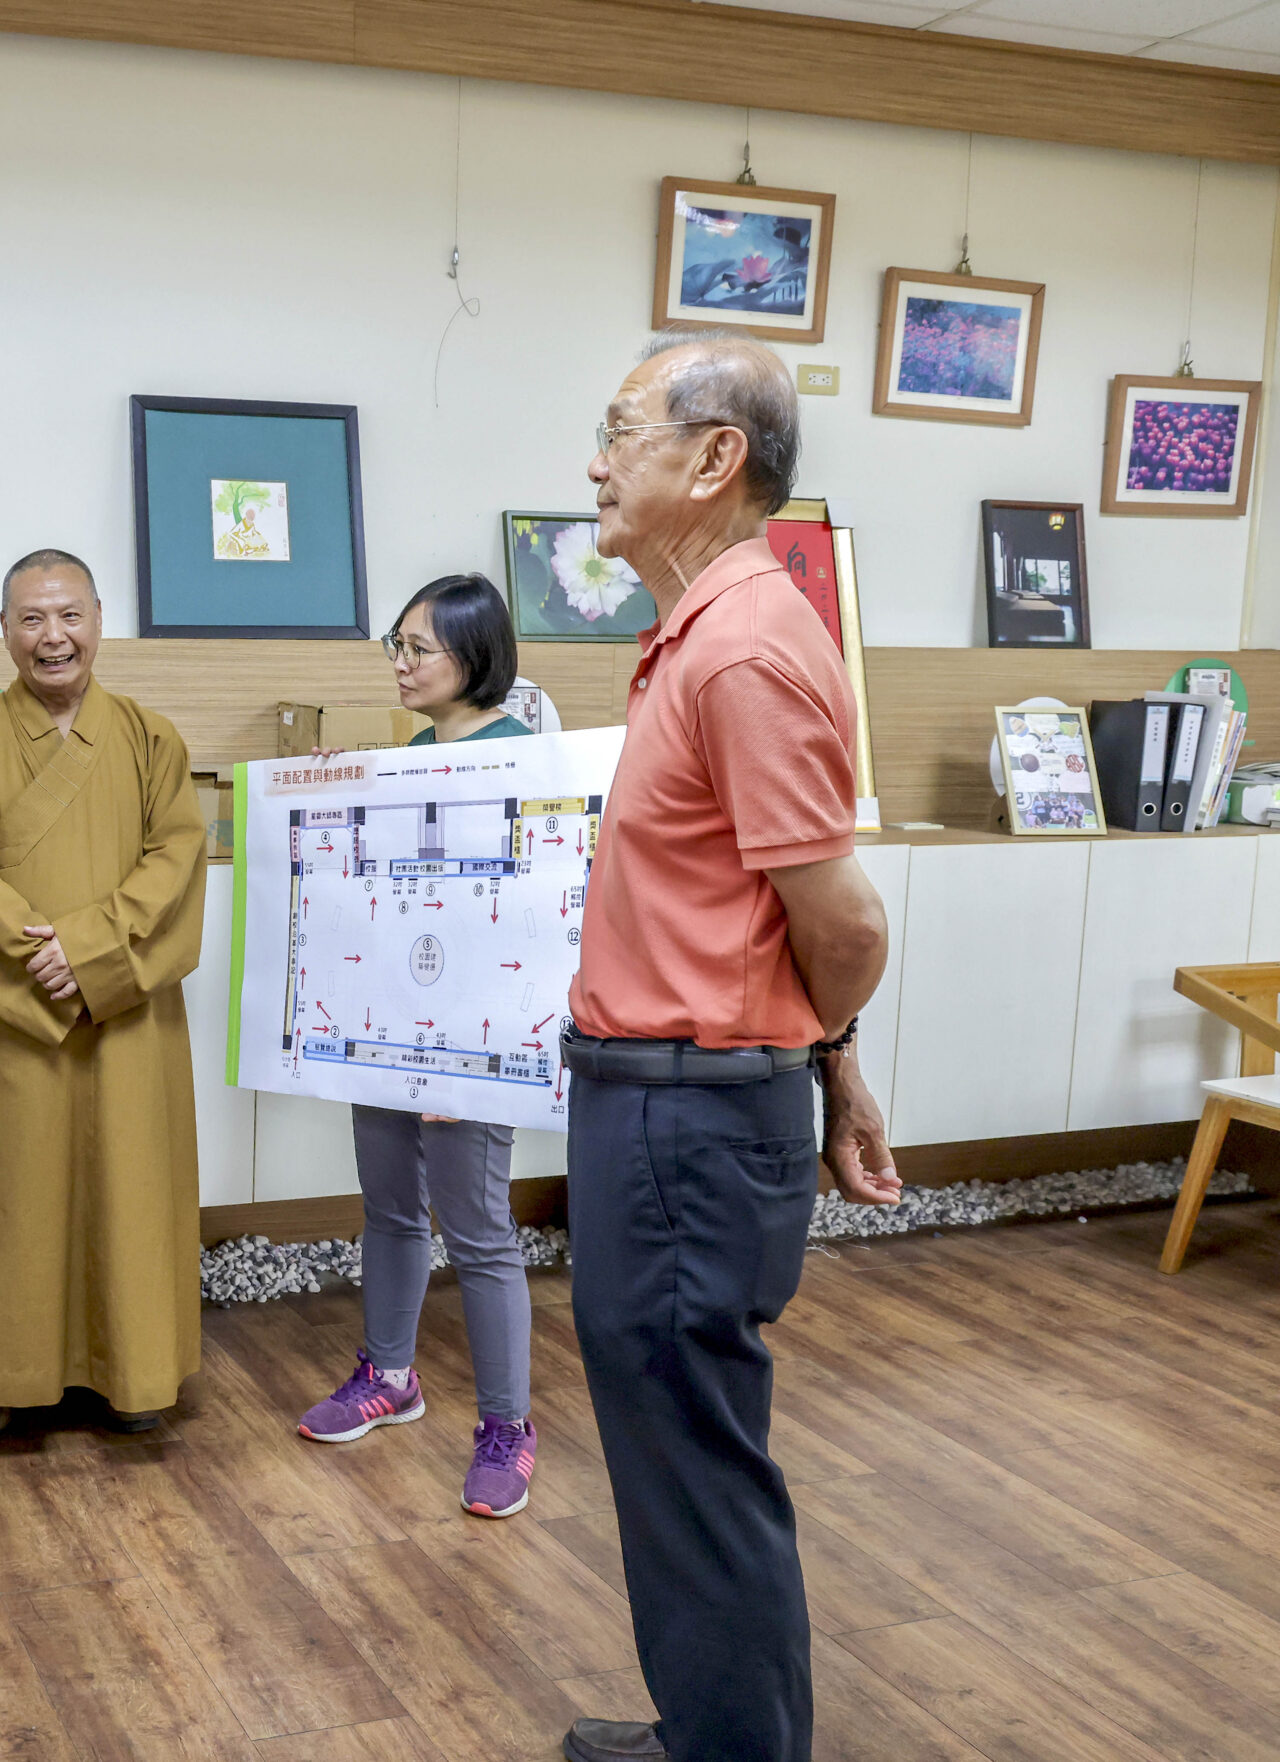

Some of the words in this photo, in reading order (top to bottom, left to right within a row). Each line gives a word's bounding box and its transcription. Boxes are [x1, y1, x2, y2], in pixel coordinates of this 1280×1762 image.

[272, 765, 365, 786] 平面配置與動線規劃
[395, 865, 419, 873] 社團活動
[419, 865, 444, 873] 校園出版
[472, 863, 497, 872] 國際交流
[401, 1054, 436, 1065] 精彩校園生活
[509, 1053, 528, 1063] 互動區
[290, 1071, 301, 1079] 入口
[404, 1076, 428, 1086] 入口意象
[551, 1105, 565, 1113] 出口
